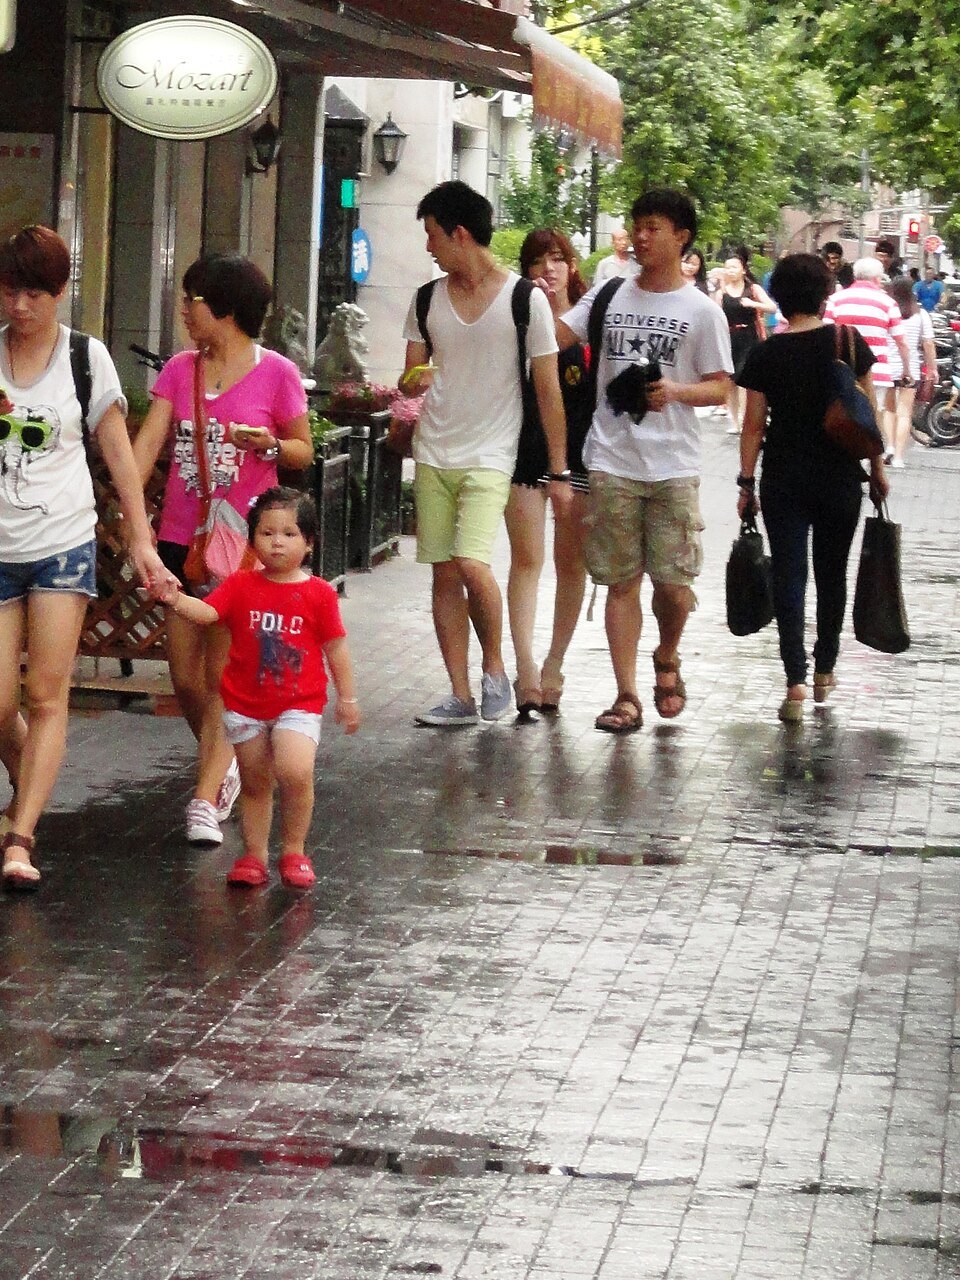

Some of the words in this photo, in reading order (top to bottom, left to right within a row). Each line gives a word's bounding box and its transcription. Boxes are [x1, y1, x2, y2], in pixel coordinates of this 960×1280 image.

[115, 59, 254, 92] Mozart
[605, 312, 690, 334] CONVERSE
[248, 610, 304, 635] POLO
